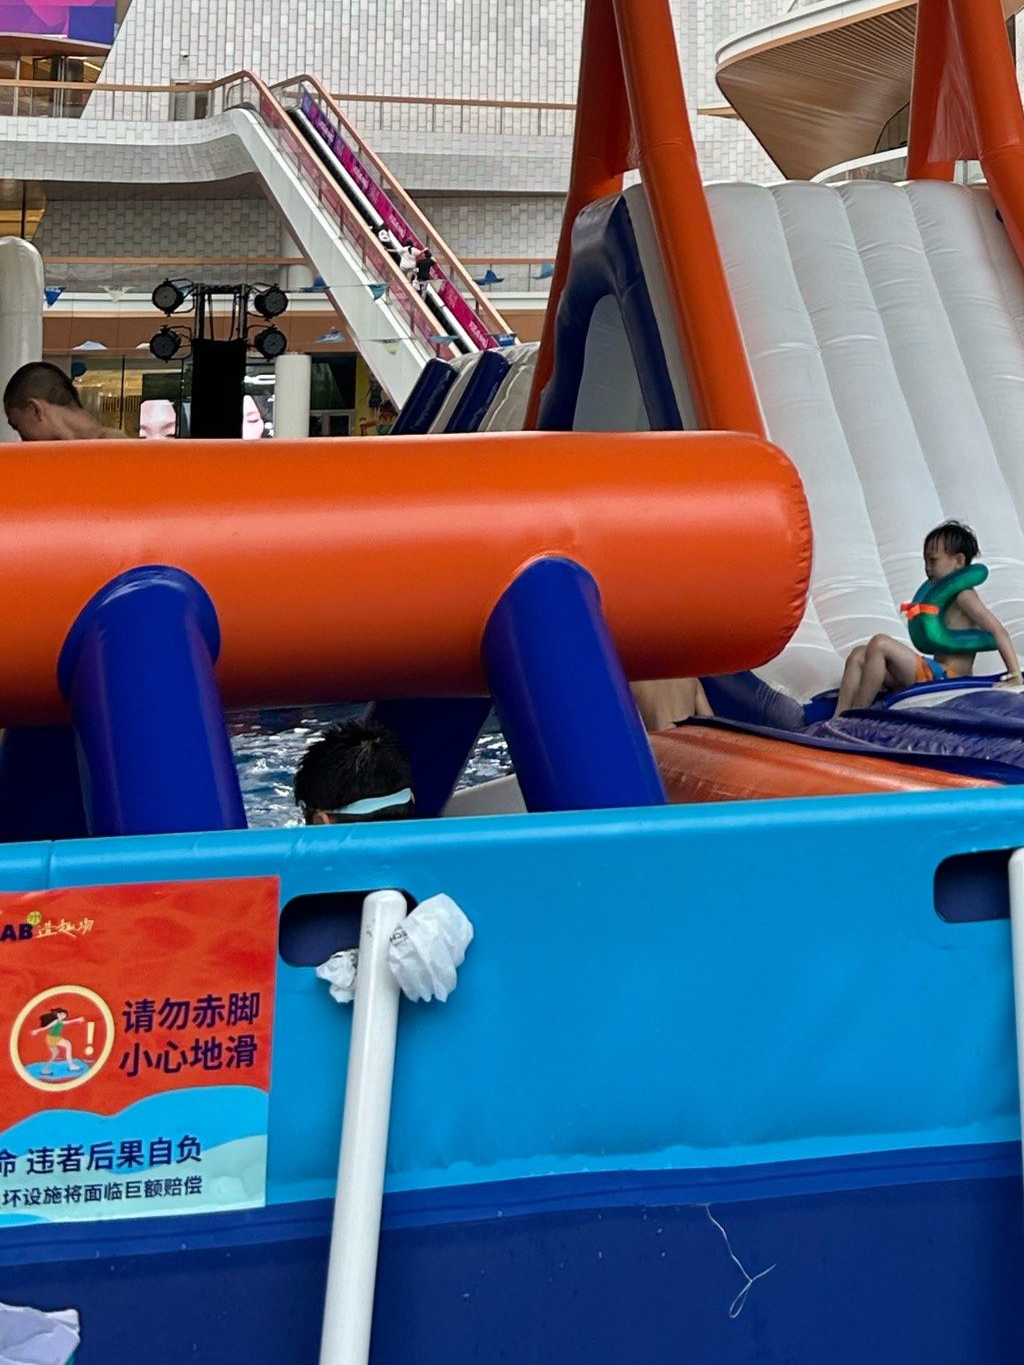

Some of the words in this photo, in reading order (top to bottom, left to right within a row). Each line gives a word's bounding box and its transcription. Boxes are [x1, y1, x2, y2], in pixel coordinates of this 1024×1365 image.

[121, 991, 261, 1034] 请勿赤脚
[118, 1033, 258, 1078] 小心地滑
[26, 1134, 203, 1175] 违者后果自负
[0, 1175, 203, 1209] 坏设施将面临巨额赔偿
